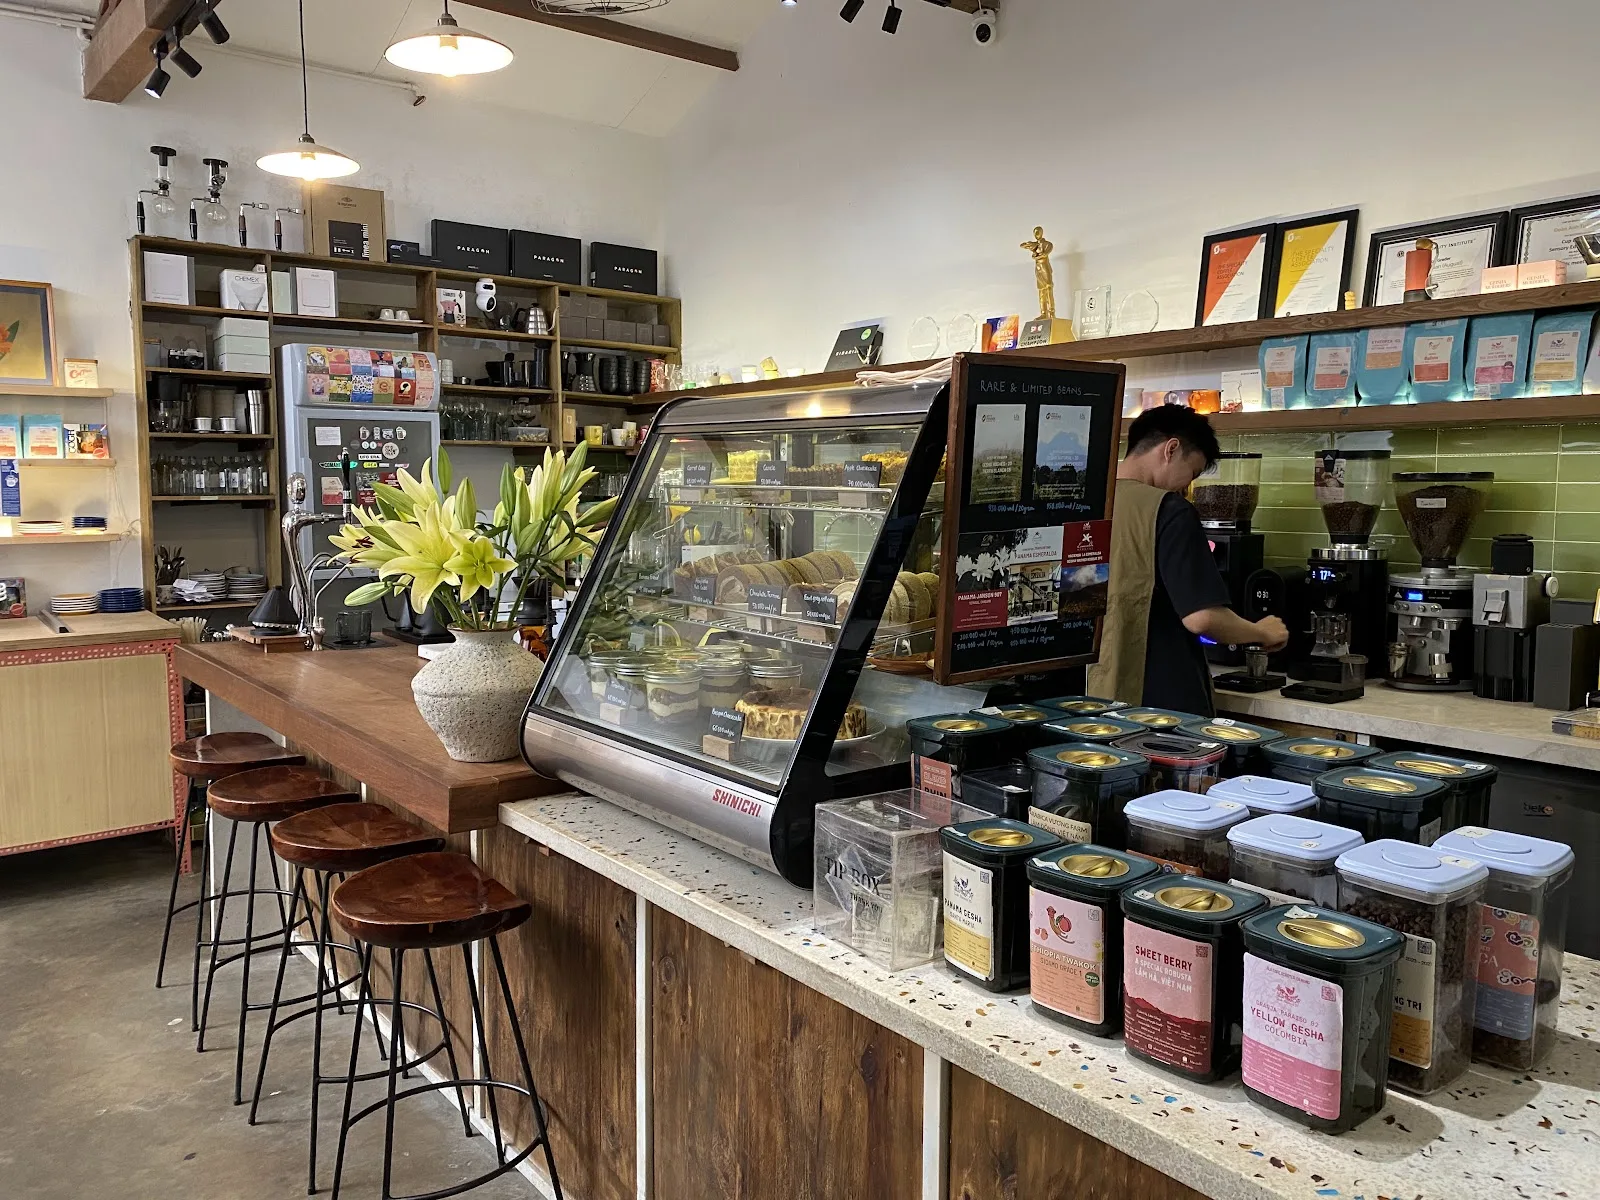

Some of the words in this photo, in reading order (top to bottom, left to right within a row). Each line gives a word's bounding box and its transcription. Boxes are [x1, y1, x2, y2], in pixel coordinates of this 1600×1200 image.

[361, 223, 369, 239] mini
[457, 246, 490, 254] PARAGON
[1448, 240, 1473, 248] INSTITUTE
[1304, 246, 1335, 256] SPECIALTY
[533, 255, 564, 263] PARAGON
[1291, 257, 1329, 268] ASSOCIATION
[614, 266, 643, 274] PARAGON
[1216, 271, 1245, 280] ASSOCIATION
[234, 275, 259, 283] CHEMEX
[1081, 315, 1101, 323] BREW
[997, 340, 1013, 349] 2025
[980, 380, 1005, 392] RARE
[1010, 383, 1017, 393] &
[1022, 383, 1053, 395] LIMITED
[1057, 385, 1082, 395] BEANS
[712, 788, 761, 817] SHINICHI
[1070, 822, 1088, 834] FARM
[825, 856, 846, 880] TIP
[851, 868, 880, 896] BOX
[850, 892, 870, 907] THANK
[870, 899, 883, 913] YOU
[944, 897, 962, 915] PANAMA
[963, 908, 983, 924] GESHA
[1030, 943, 1060, 961] ETHIOPIA
[1061, 954, 1097, 971] TWAKOK
[1135, 945, 1162, 962] SWEET
[1163, 954, 1193, 972] BERRY
[1059, 965, 1077, 976] GRADE
[1140, 960, 1163, 973] SPECIAL
[1164, 967, 1192, 982] ROBUSTA
[1161, 976, 1175, 988] VIỆT
[1176, 981, 1192, 993] NAM
[1250, 1006, 1285, 1028] YELLOW
[1291, 1023, 1324, 1042] GESHA
[1264, 1024, 1309, 1047] COLOMBIA
